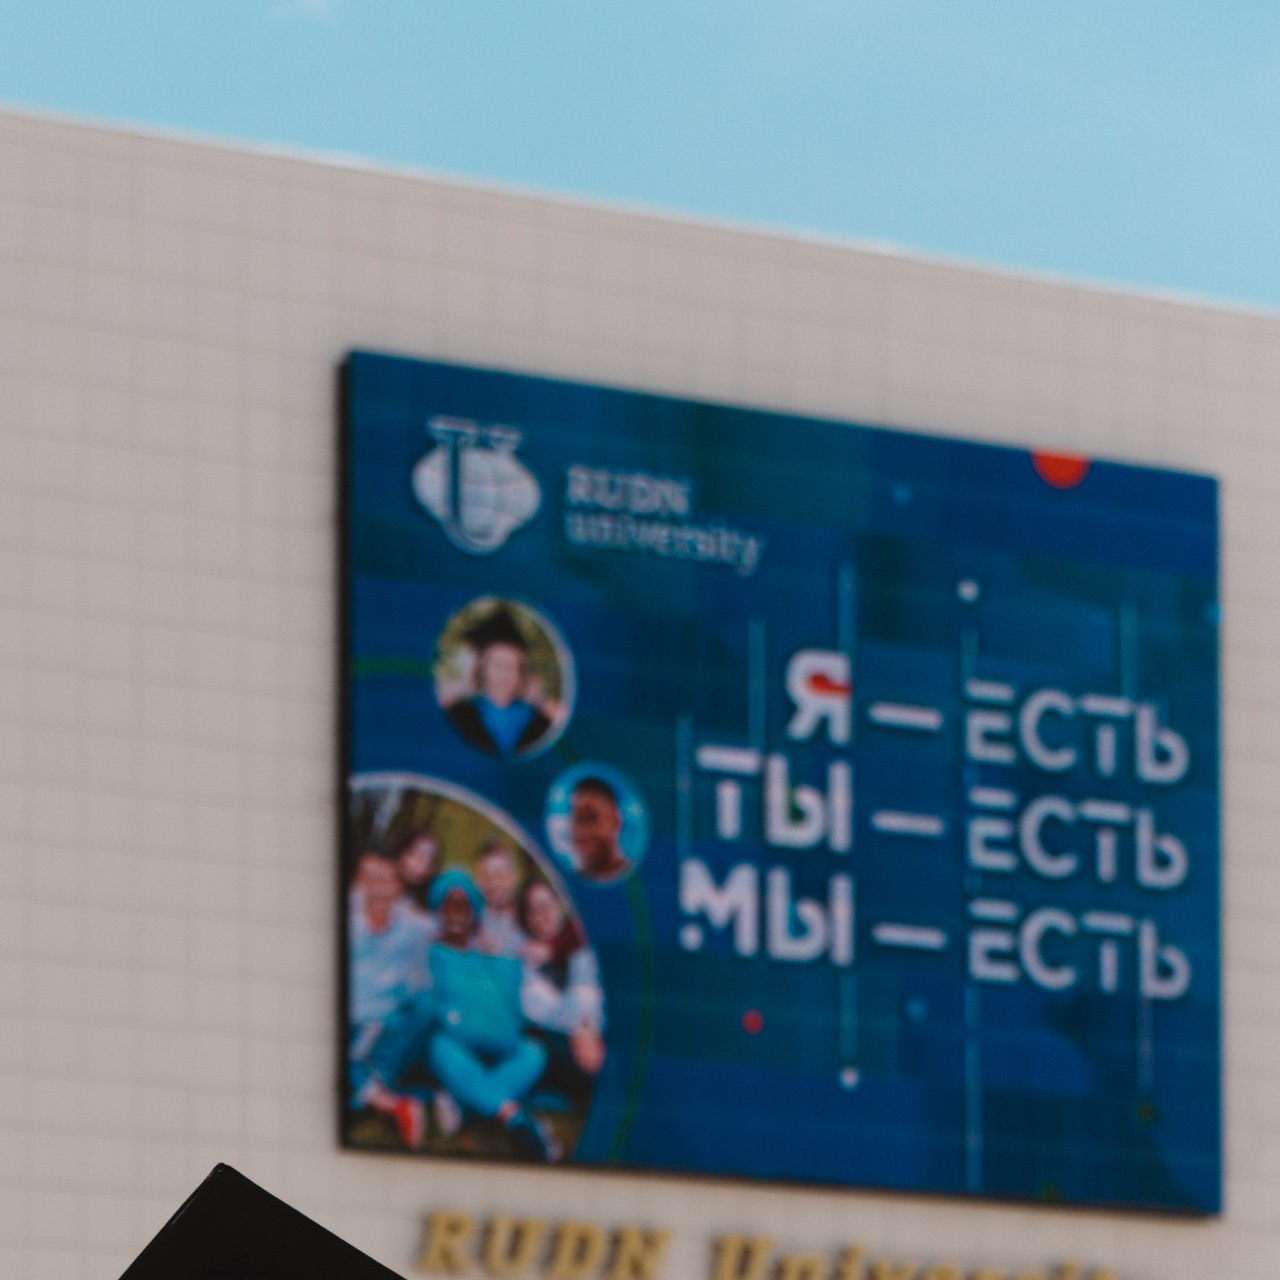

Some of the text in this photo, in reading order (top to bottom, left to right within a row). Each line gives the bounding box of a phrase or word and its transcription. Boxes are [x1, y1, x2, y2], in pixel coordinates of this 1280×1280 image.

[568, 464, 692, 517] RUDN
[568, 511, 764, 575] university
[787, 649, 850, 744] Я
[965, 679, 1189, 784] ЕСТЬ
[697, 745, 852, 852] ТЫ
[967, 787, 1189, 888] ЕСТЬ
[679, 858, 854, 964] МЫ
[968, 898, 1190, 998] ЕСТЬ
